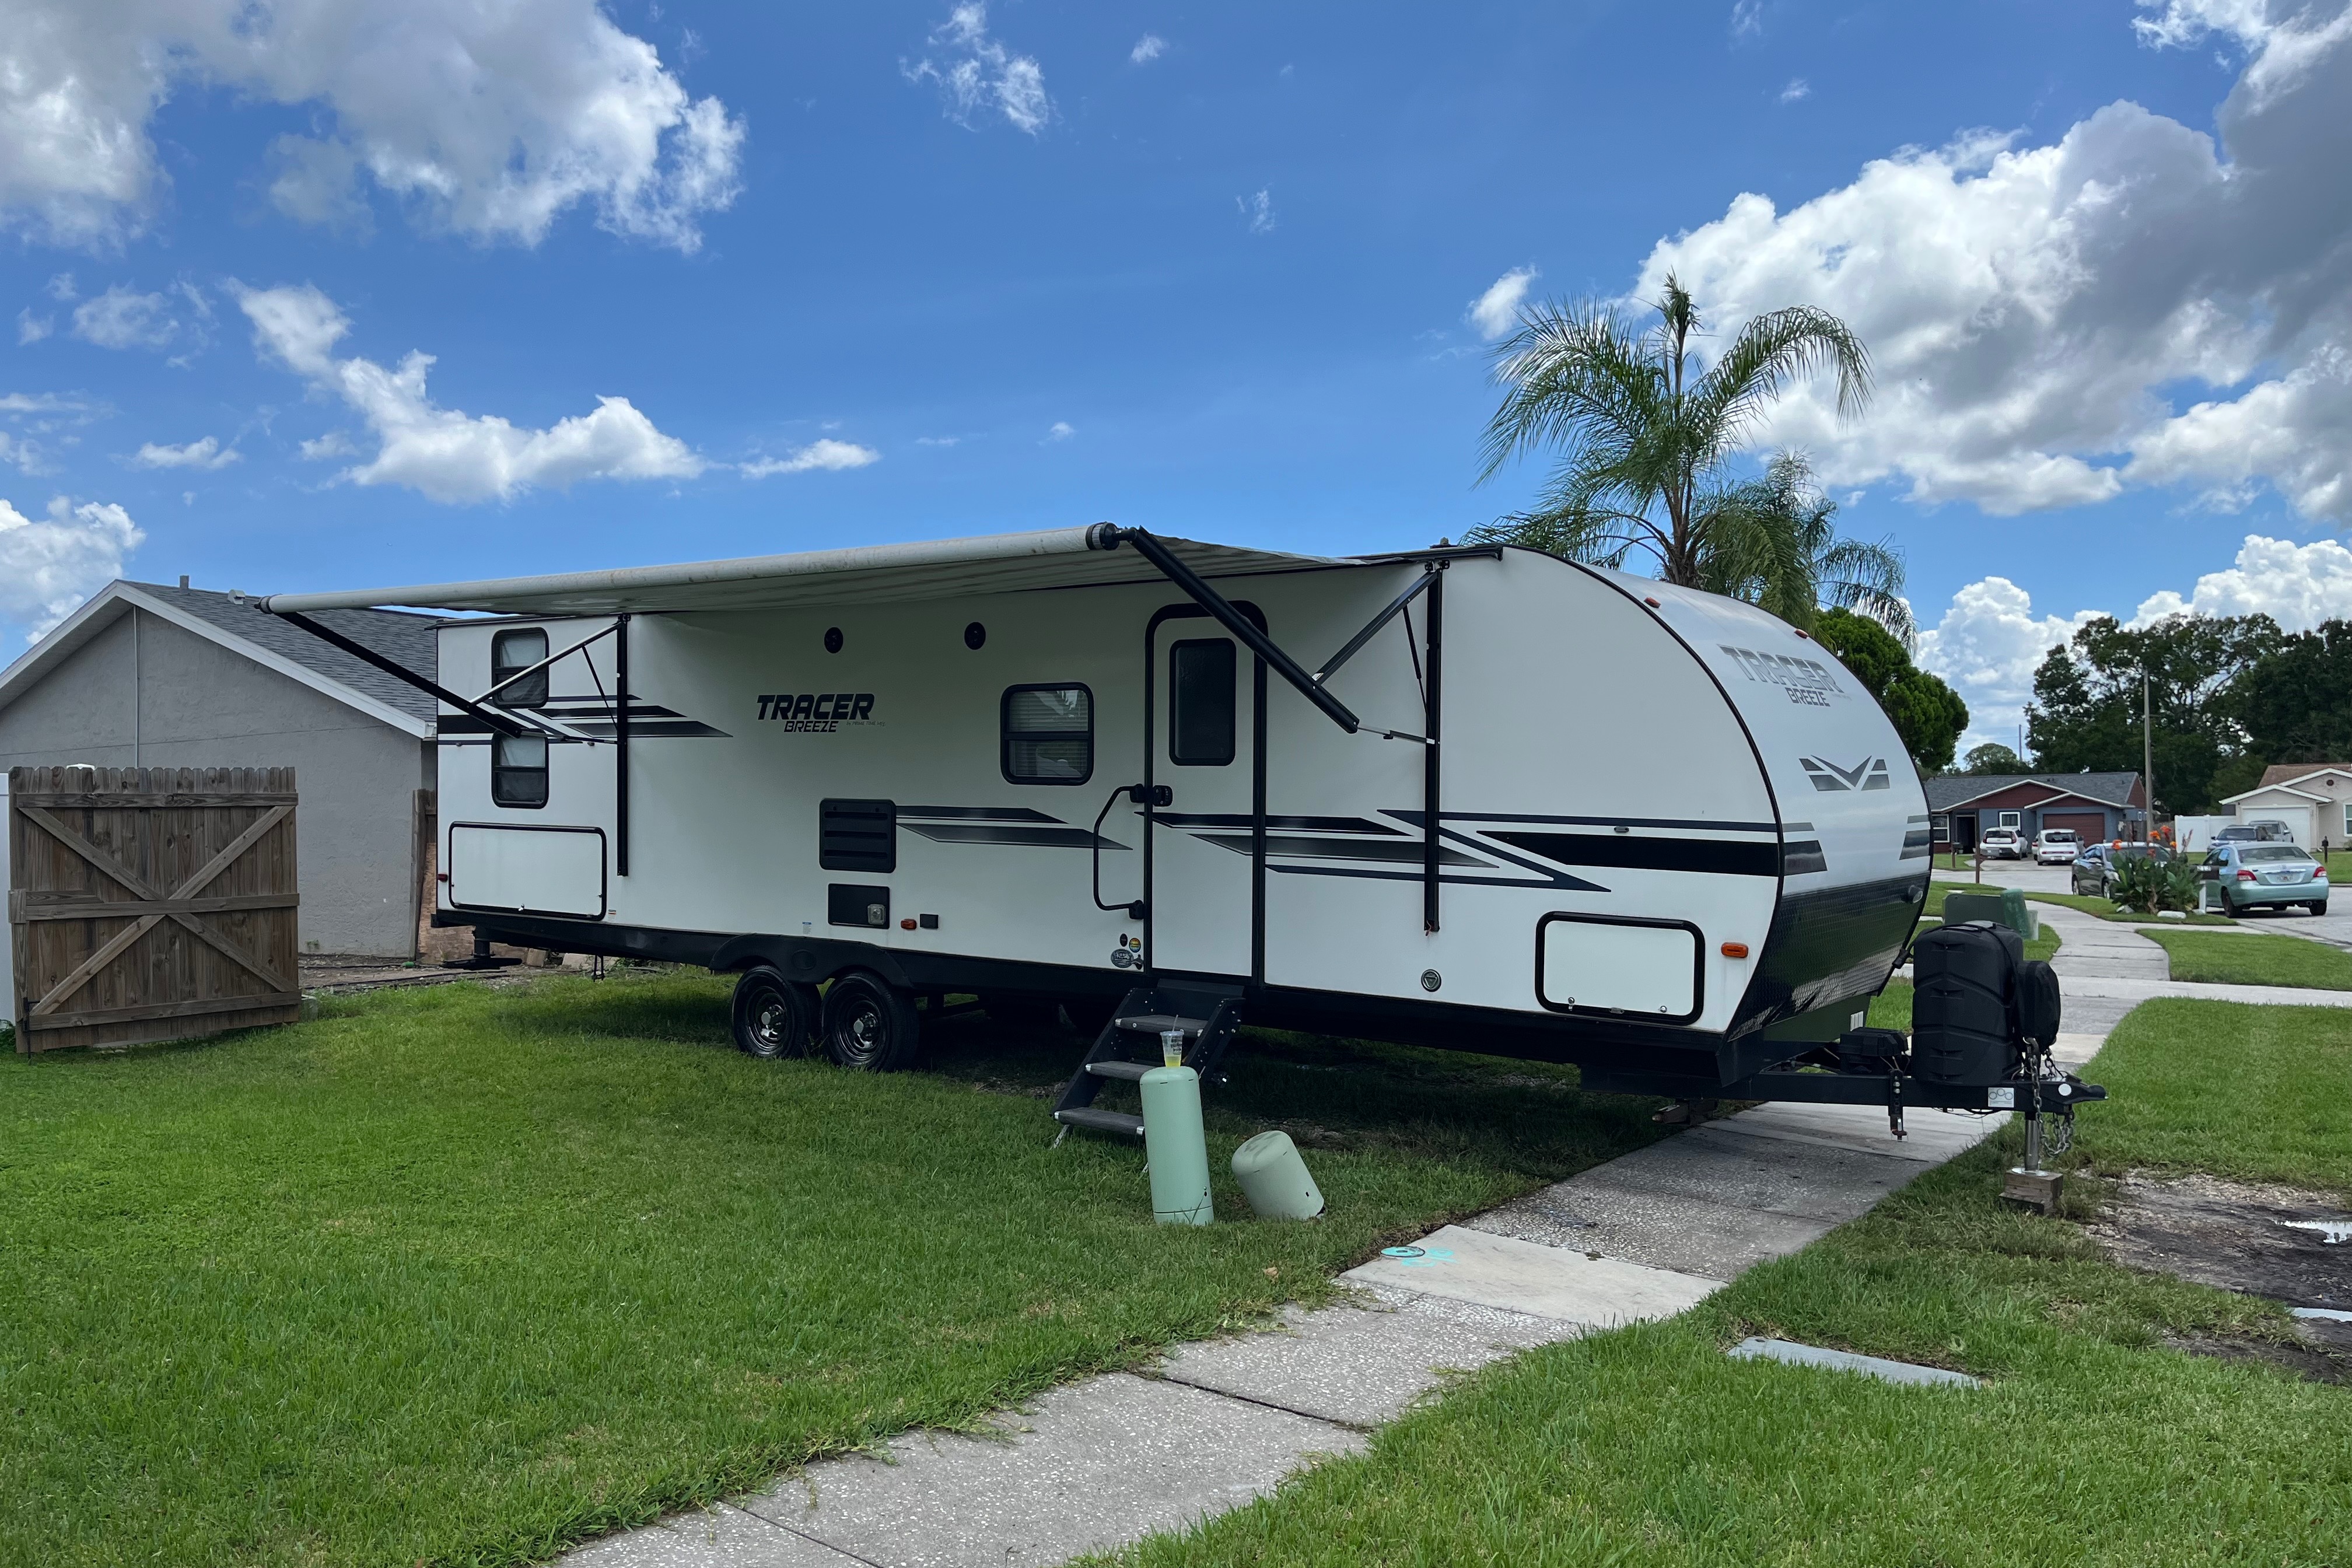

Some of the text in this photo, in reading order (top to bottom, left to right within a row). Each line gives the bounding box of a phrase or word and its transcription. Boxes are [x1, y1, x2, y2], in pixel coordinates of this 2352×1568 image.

[1716, 643, 1845, 694] TRACER
[757, 693, 875, 720] TRACER
[1784, 687, 1831, 707] BREEZE
[783, 720, 839, 733] BREEZE
